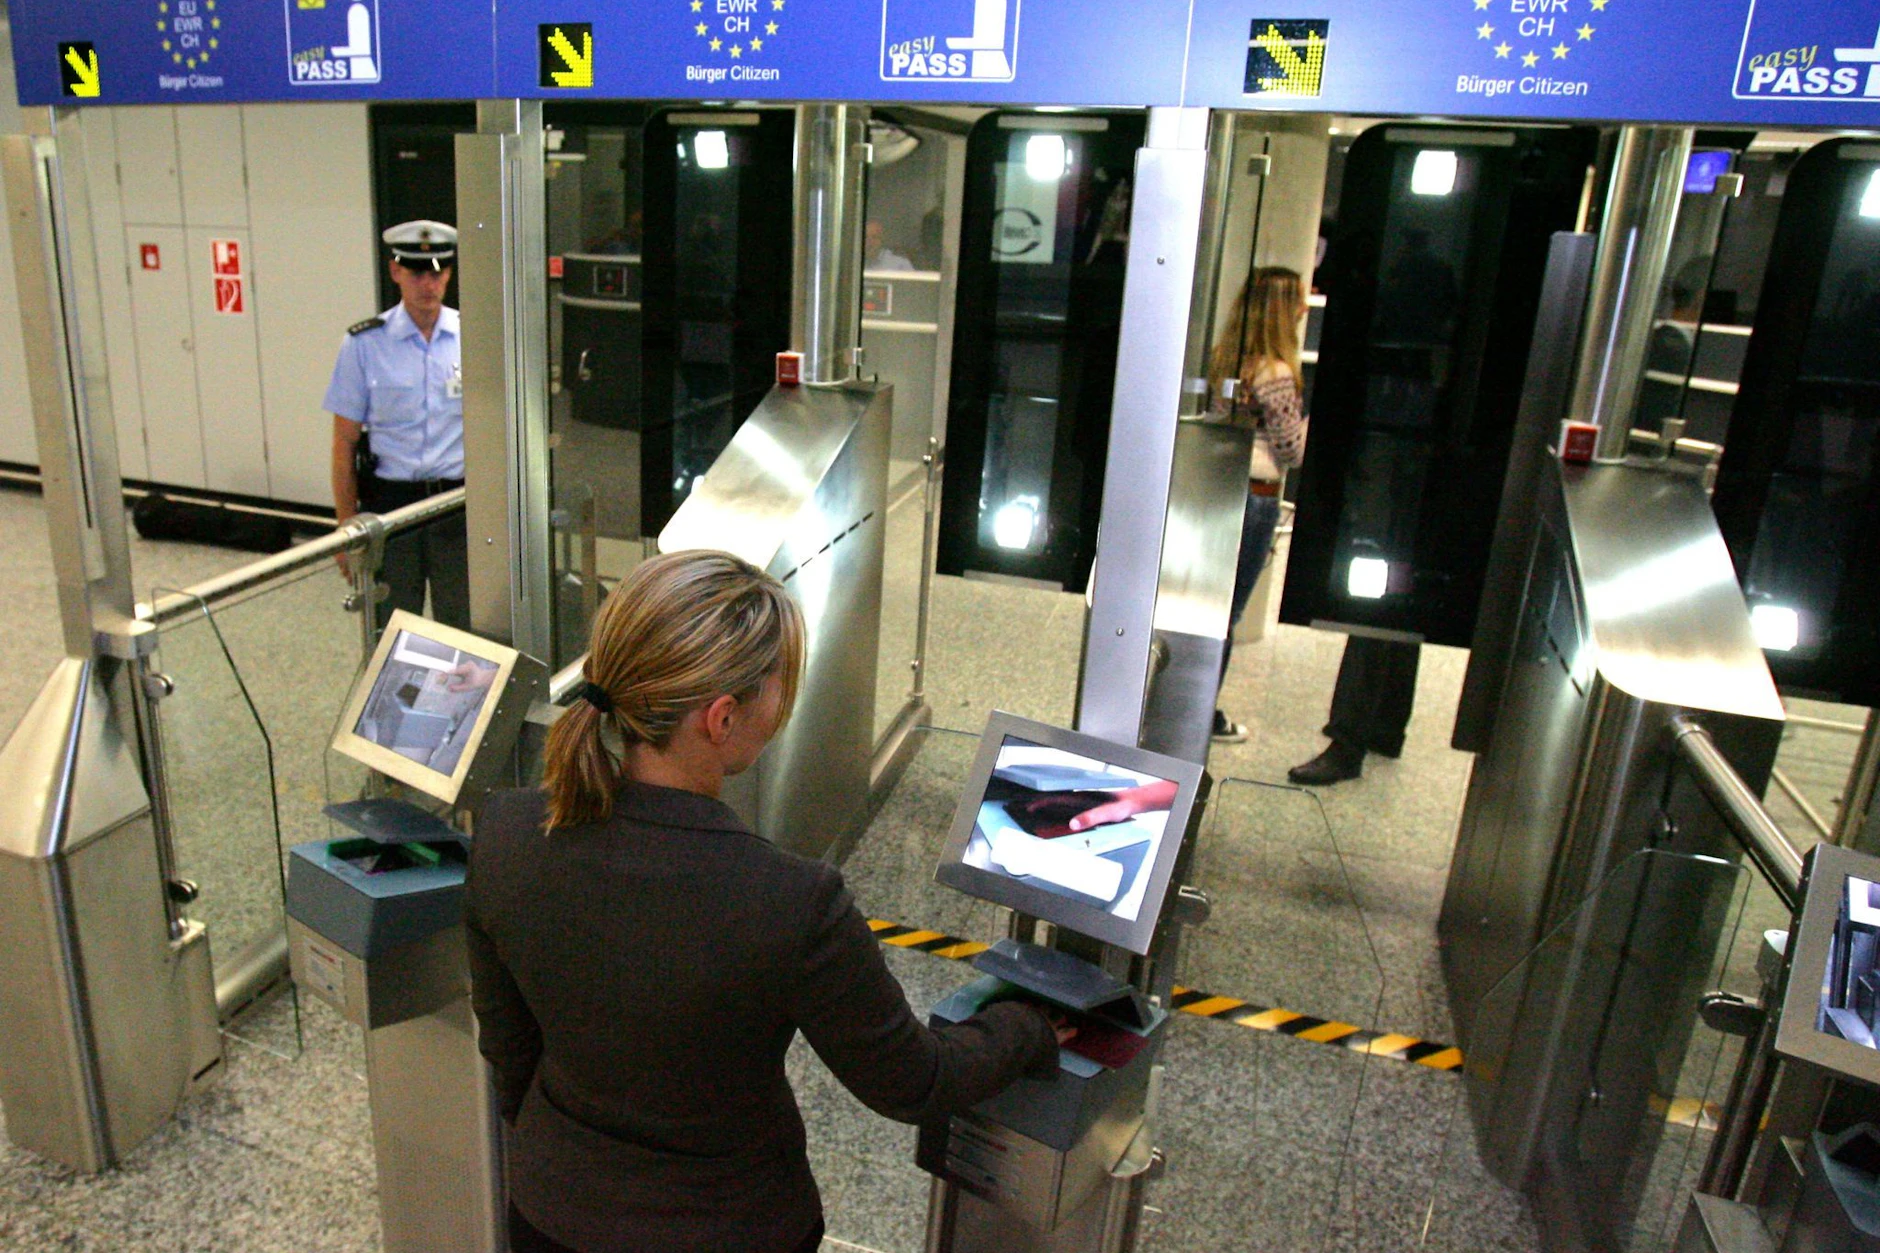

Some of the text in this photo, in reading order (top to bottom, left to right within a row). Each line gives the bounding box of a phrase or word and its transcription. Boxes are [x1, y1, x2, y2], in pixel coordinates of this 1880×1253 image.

[717, 0, 758, 13] EWR
[1510, 0, 1569, 13] EWR
[174, 16, 203, 33] EWR
[724, 16, 750, 33] CH
[1518, 16, 1555, 37] CH
[181, 33, 200, 48] CH
[888, 35, 935, 58] easy
[891, 52, 967, 76] PASS
[1748, 45, 1818, 72] easy
[296, 59, 347, 79] PASS
[686, 65, 780, 84] Bürger Citizen
[1456, 75, 1588, 97] Bürger Citizen
[1749, 66, 1859, 95] PASS
